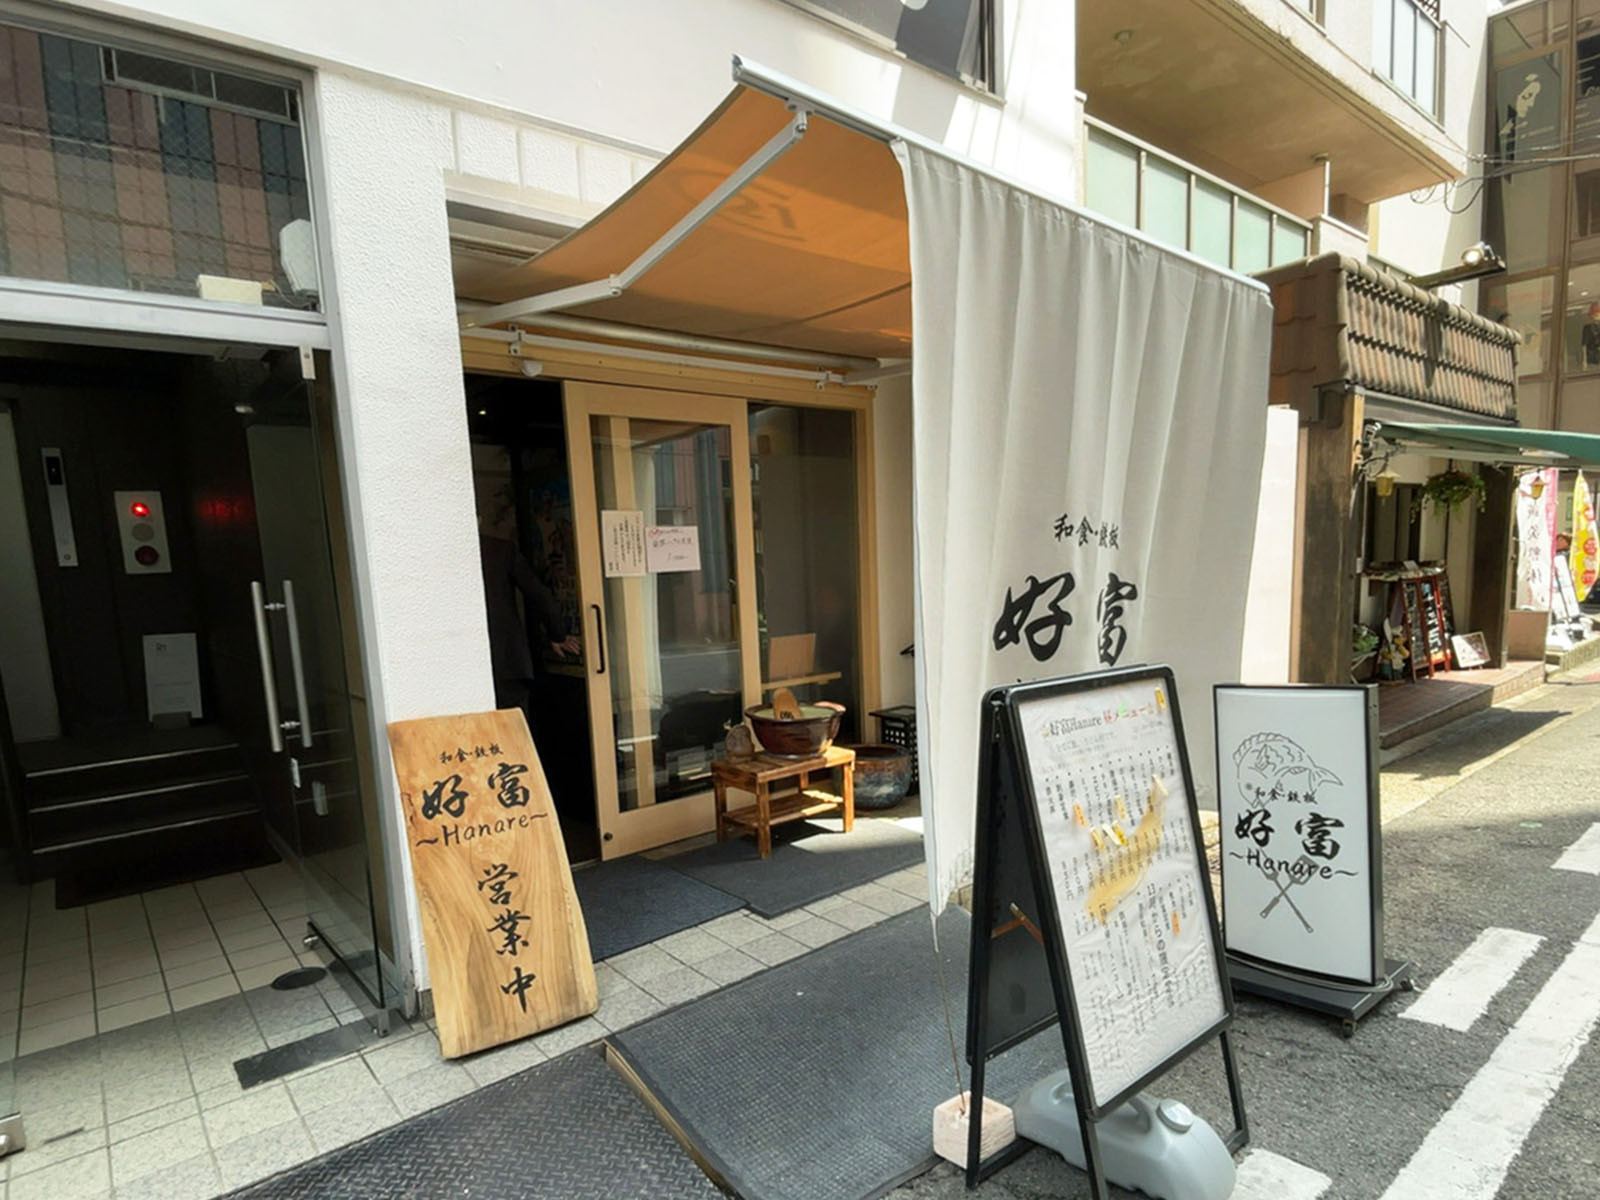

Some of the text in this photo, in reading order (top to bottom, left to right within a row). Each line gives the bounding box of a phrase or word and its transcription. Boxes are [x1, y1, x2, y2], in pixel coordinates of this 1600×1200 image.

[421, 761, 530, 820] 好富
[1234, 808, 1344, 861] 好富
[477, 863, 537, 1014] 営業中
